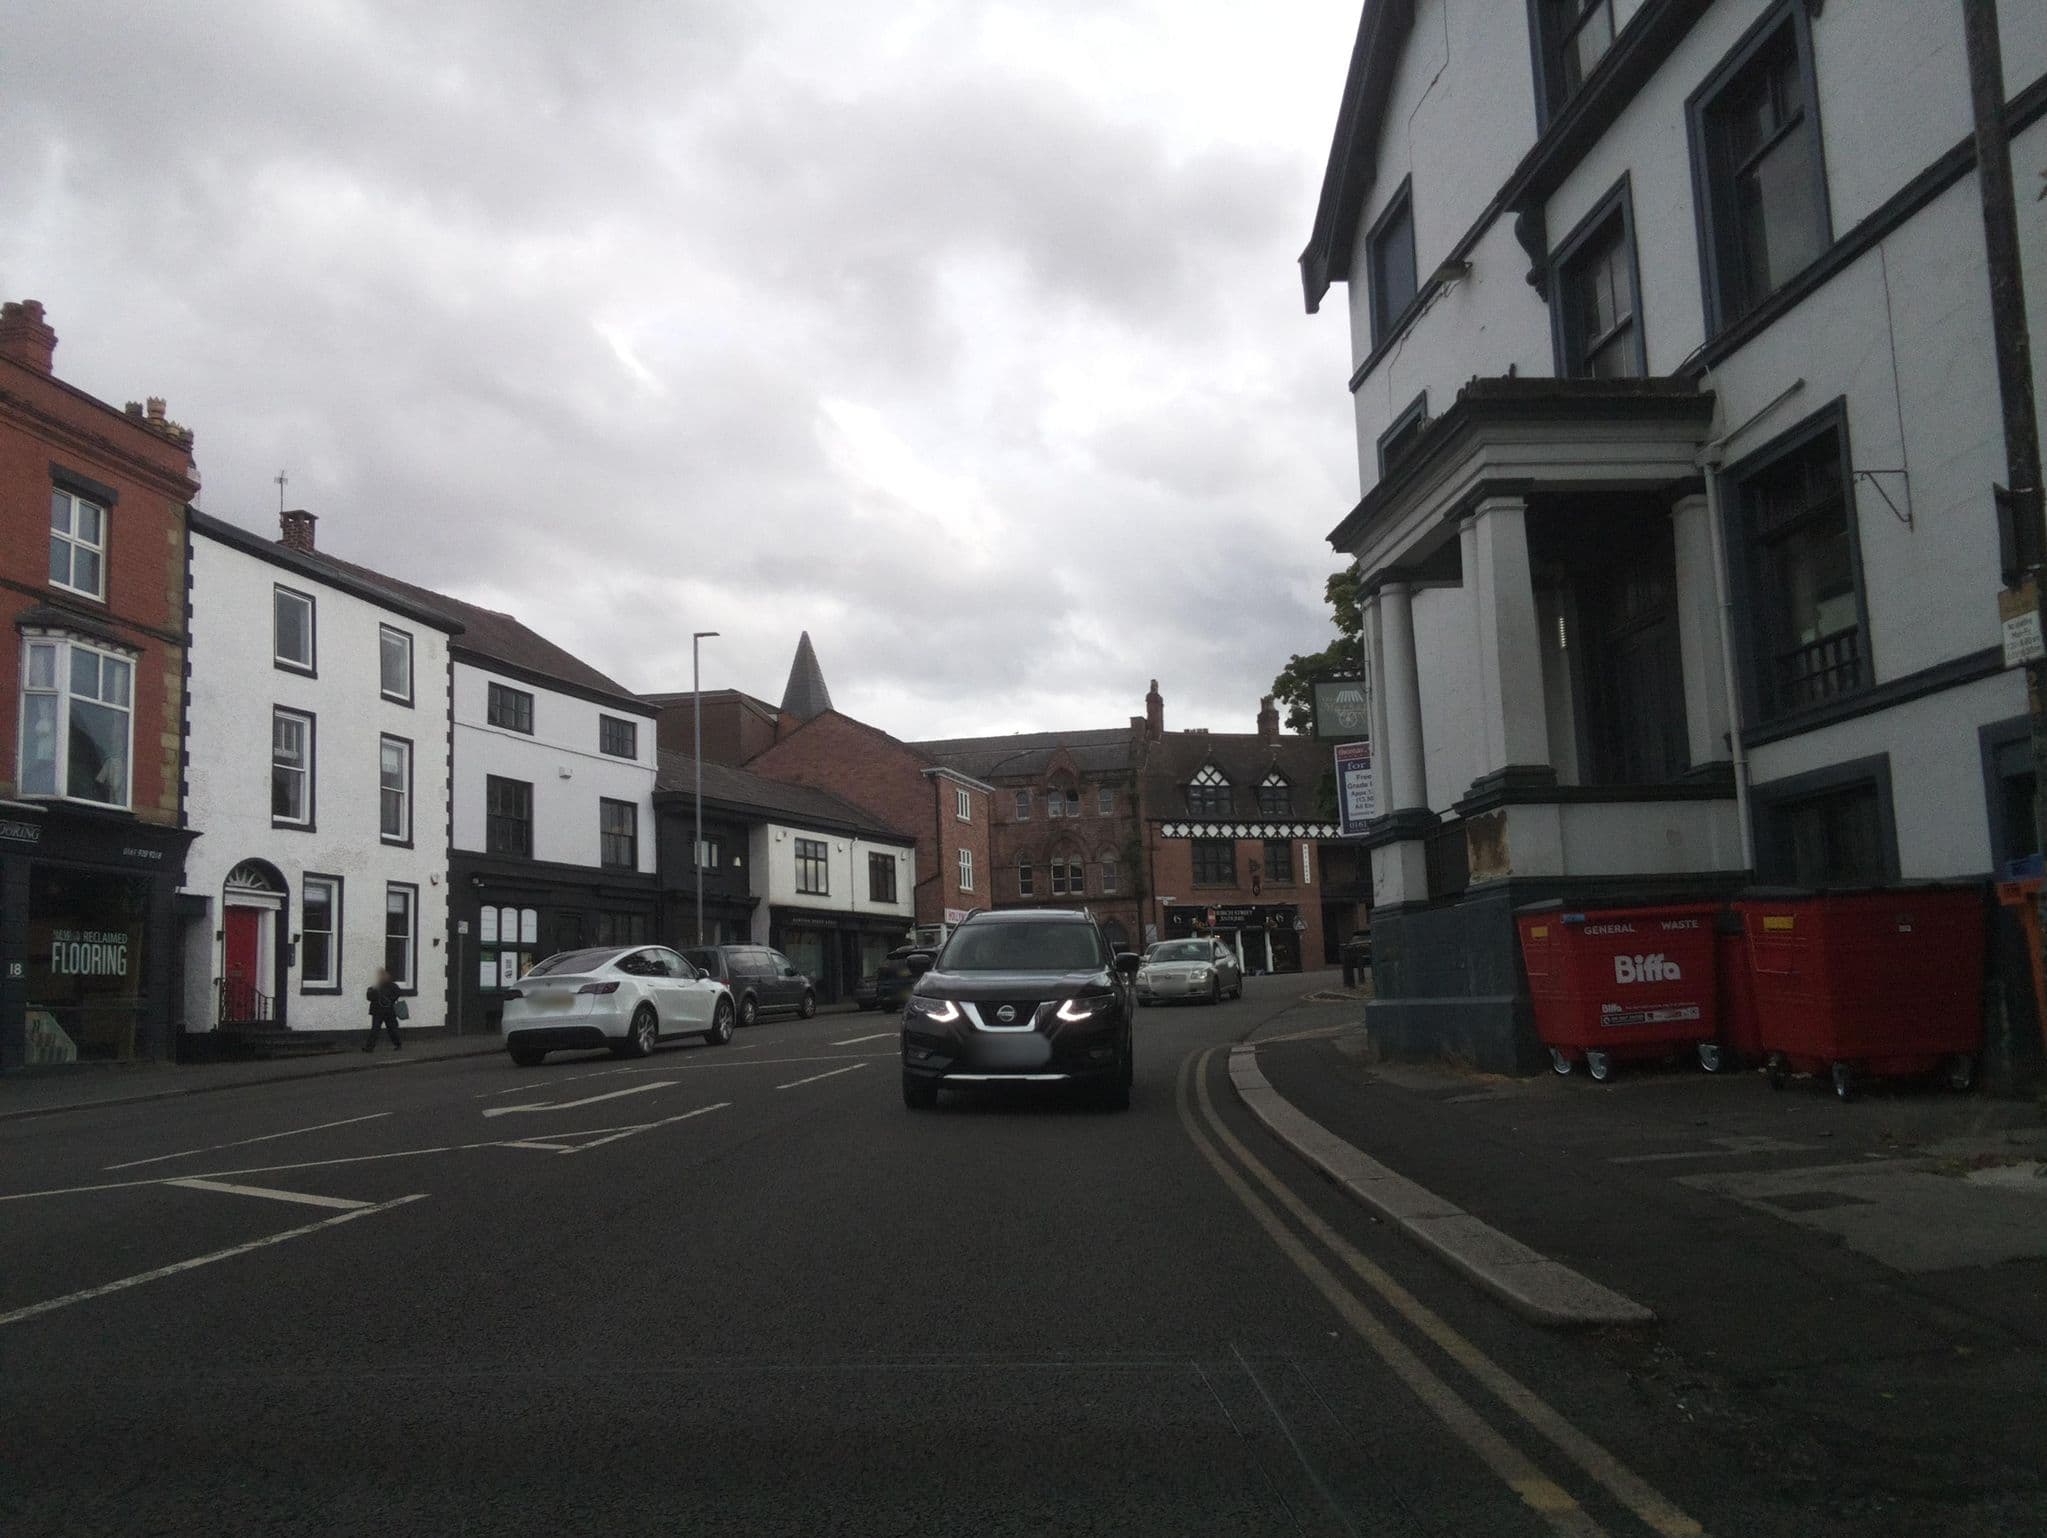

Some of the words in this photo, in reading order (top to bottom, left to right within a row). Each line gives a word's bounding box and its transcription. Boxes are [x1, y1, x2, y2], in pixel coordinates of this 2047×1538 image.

[1347, 761, 1367, 770] for
[1583, 923, 1636, 935] GENERAL
[1661, 920, 1700, 930] WASTE
[83, 931, 128, 944] RECLAIMED
[52, 941, 127, 976] FLOORING
[9, 962, 22, 975] 18
[1614, 953, 1681, 984] Biffa
